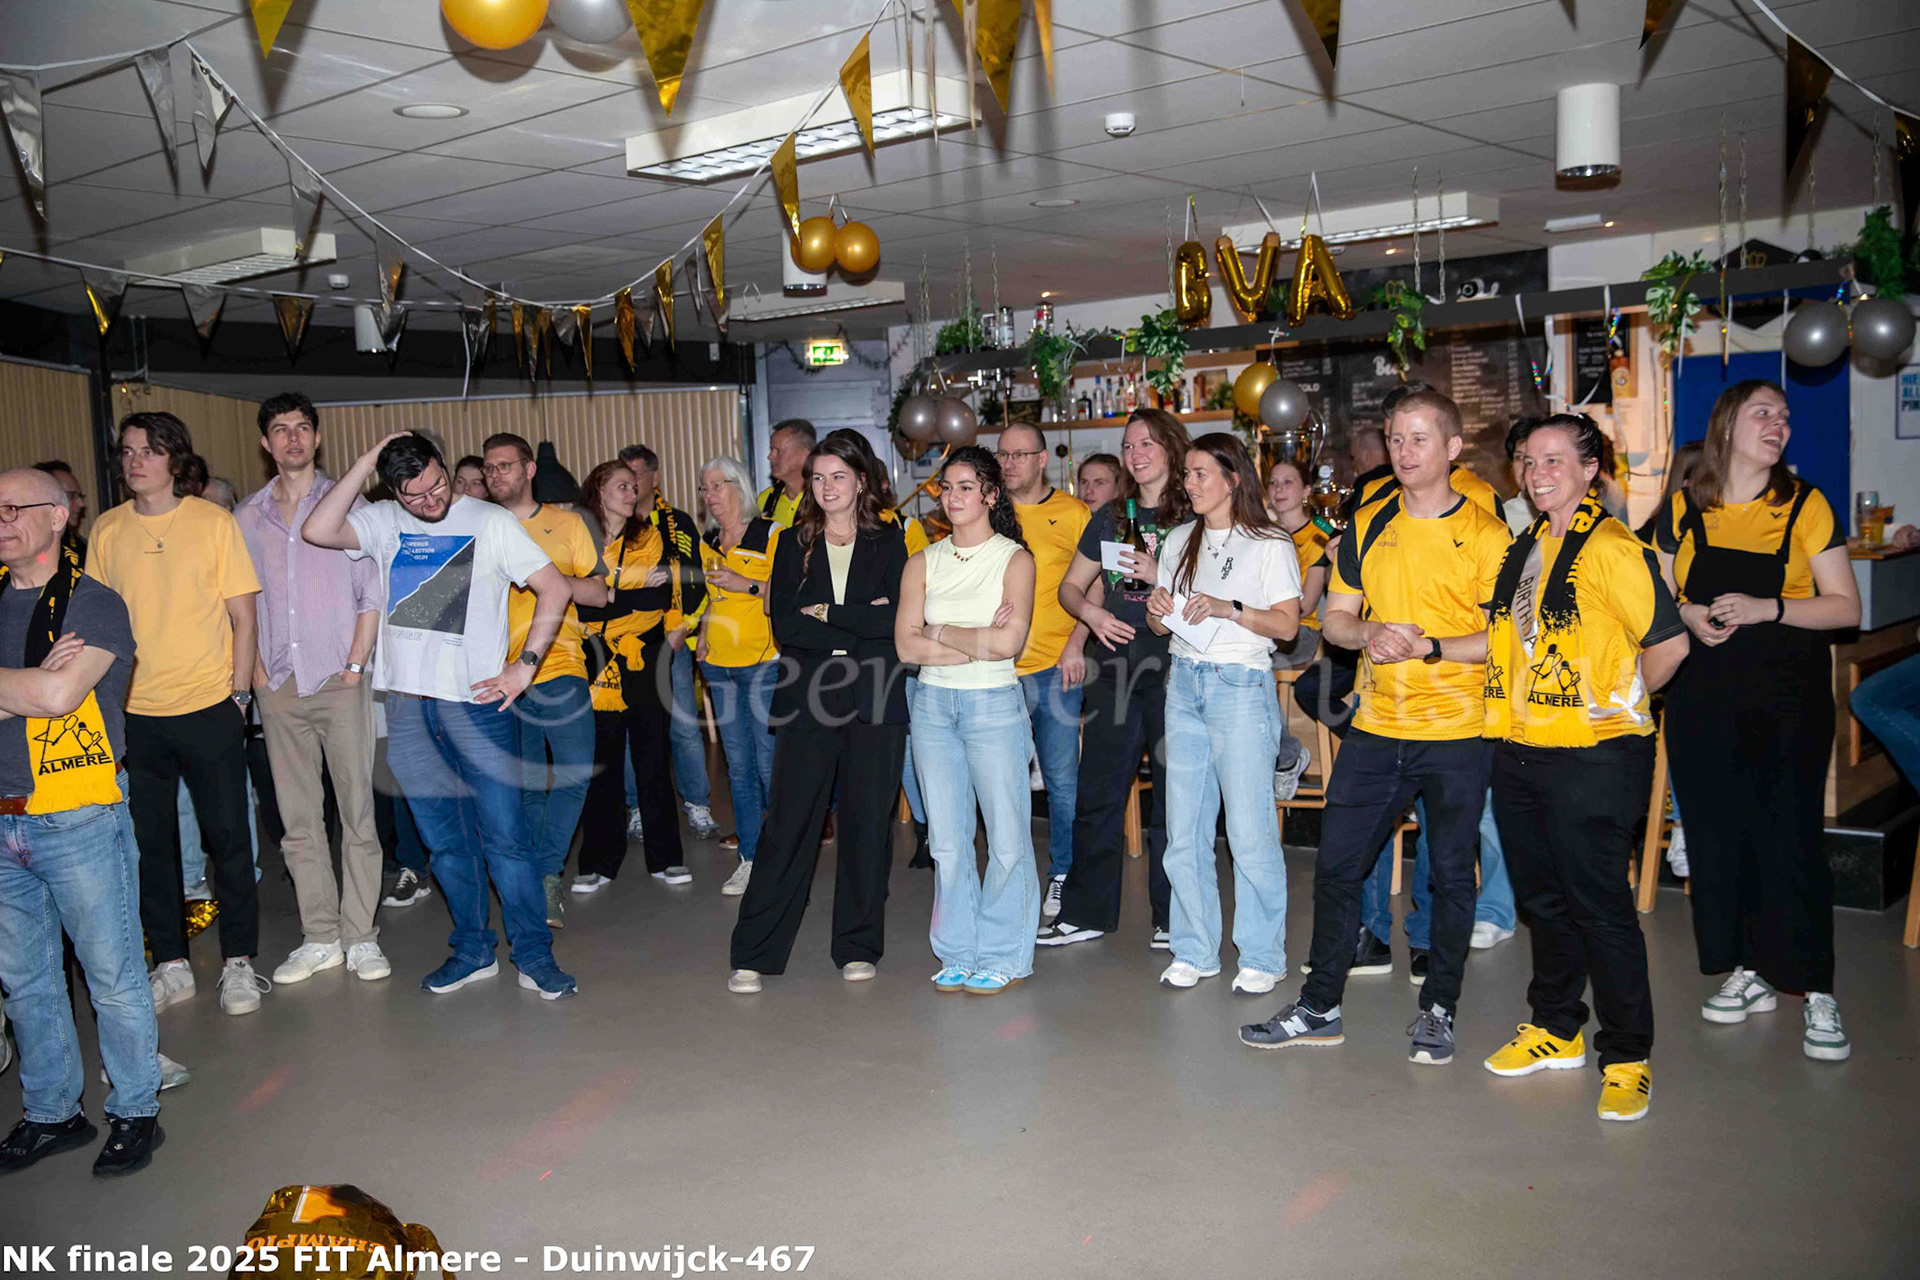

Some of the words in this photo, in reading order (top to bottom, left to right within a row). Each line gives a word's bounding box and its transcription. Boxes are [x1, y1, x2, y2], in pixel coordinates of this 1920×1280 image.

[1175, 232, 1356, 326] BVA
[1902, 374, 1920, 385] HIE
[1483, 686, 1506, 699] ERE
[38, 754, 113, 776] ALMERE
[239, 1233, 387, 1254] CHAMPIO
